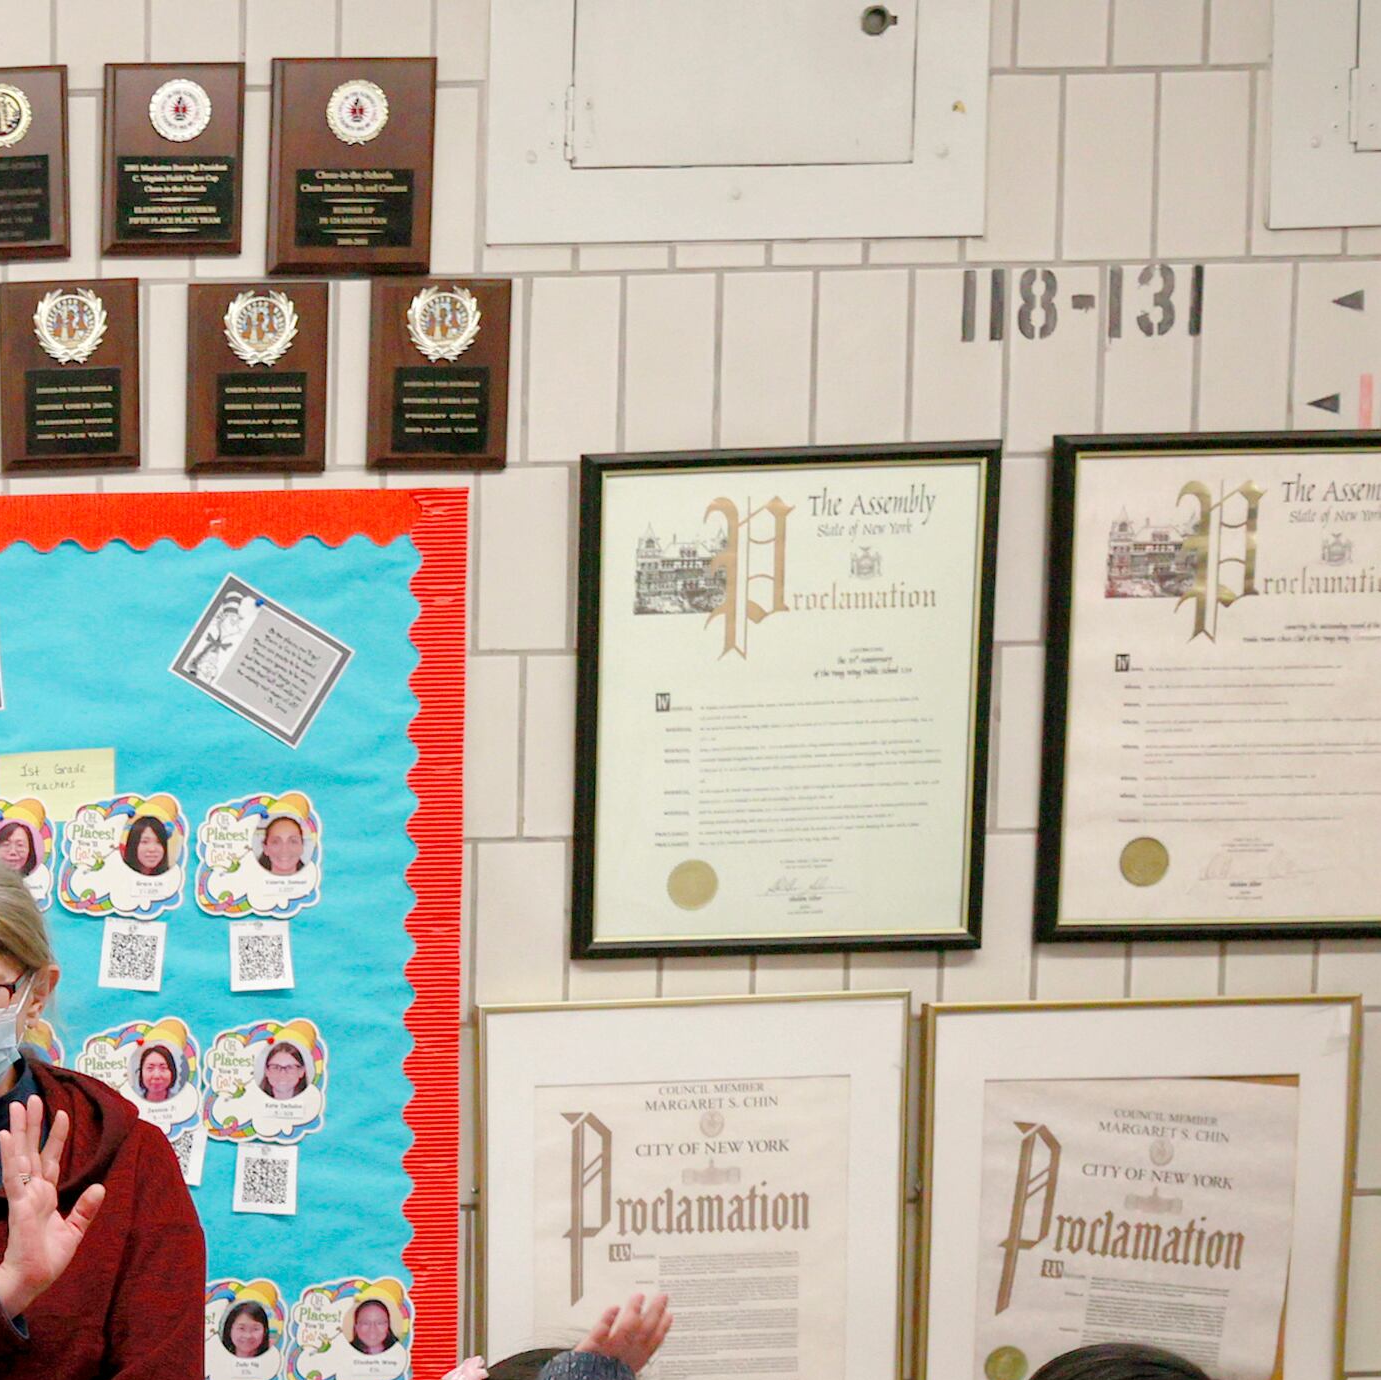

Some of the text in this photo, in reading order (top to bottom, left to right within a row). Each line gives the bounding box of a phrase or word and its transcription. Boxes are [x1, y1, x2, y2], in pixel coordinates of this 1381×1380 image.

[1282, 473, 1315, 503] The
[809, 483, 936, 525] The Assembly
[1289, 507, 1381, 528] State of New Yor
[817, 518, 913, 542] State of New York
[703, 495, 938, 661] Proclamation
[20, 763, 87, 777] 1st Grade
[26, 780, 77, 791] Teachers
[72, 825, 115, 840] Places!
[75, 847, 91, 861] Go!
[659, 1083, 765, 1095] COUNCIL MEMBER
[645, 1096, 779, 1112] MARGARET S. CHIN
[1114, 1109, 1218, 1127] COUNCIL MEMBER
[1099, 1121, 1177, 1139] MARGARET
[1196, 1130, 1230, 1144] CHIN
[635, 1139, 790, 1157] CITY OF NEW YORK
[1082, 1163, 1234, 1190] CITY OF NEW YORK
[560, 1112, 809, 1308] Proclamation
[995, 1121, 1245, 1316] Proclamation
